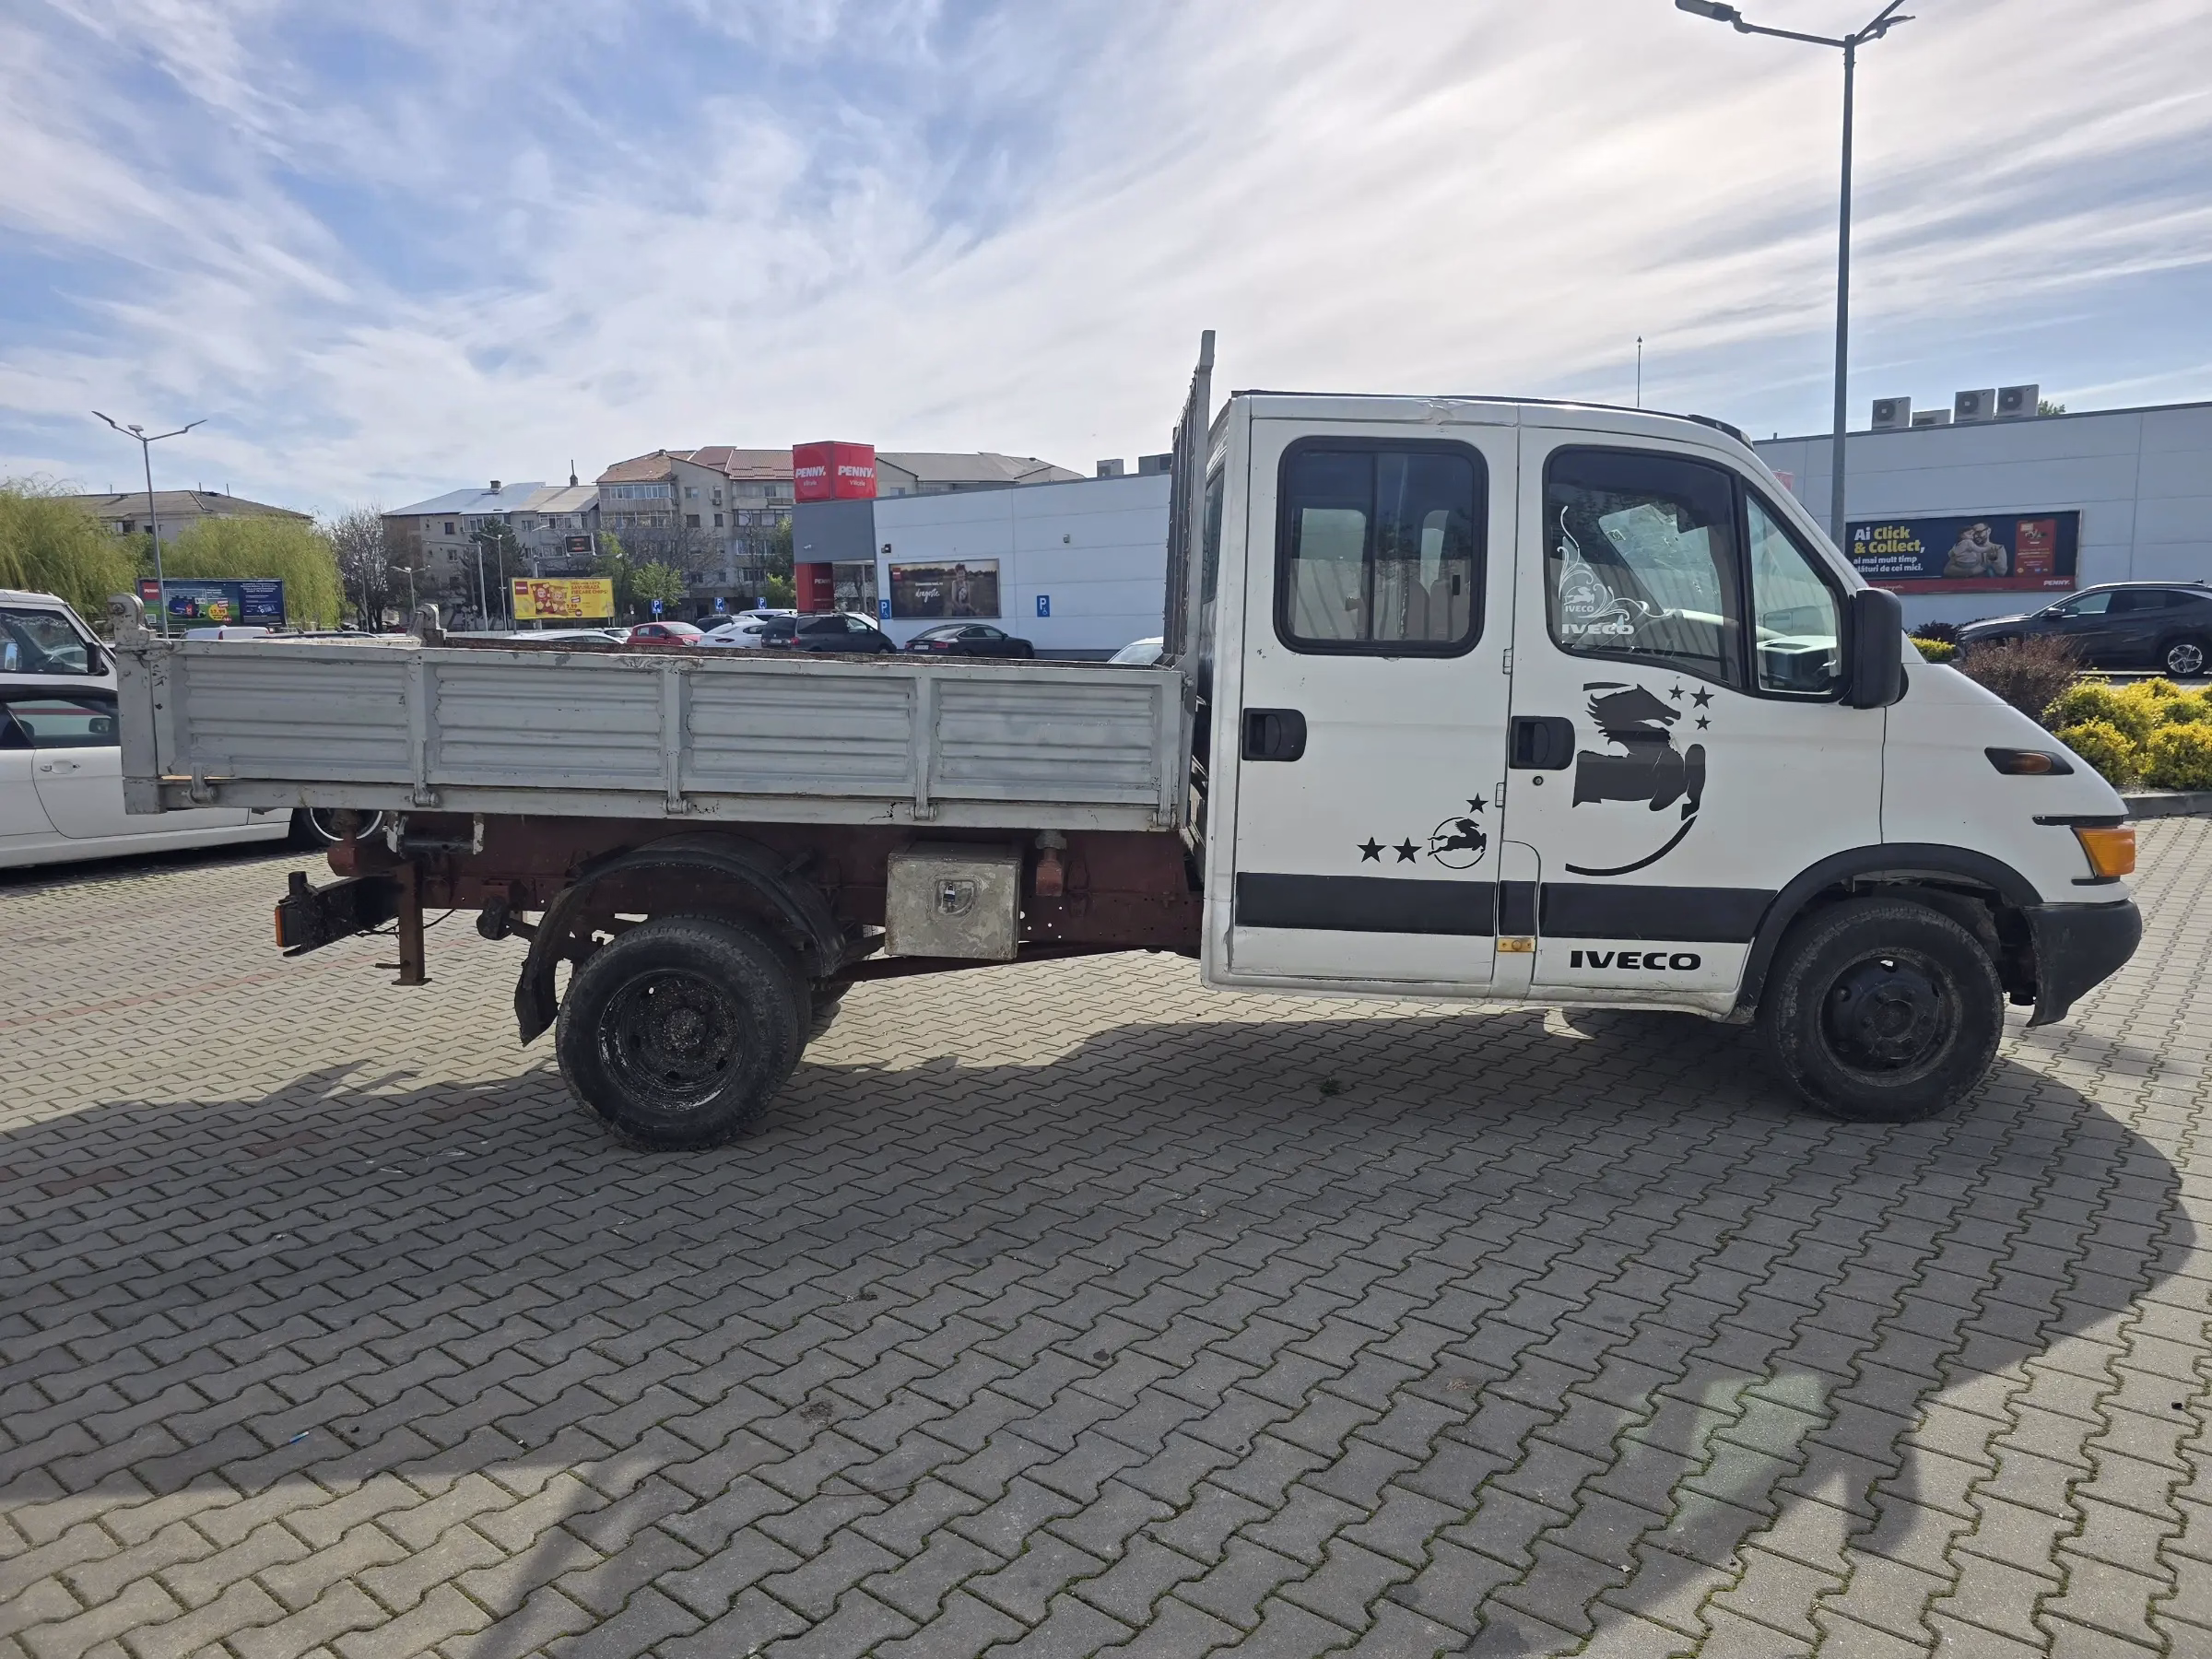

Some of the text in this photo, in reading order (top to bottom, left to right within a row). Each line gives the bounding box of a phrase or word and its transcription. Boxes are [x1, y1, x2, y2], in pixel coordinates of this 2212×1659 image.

[1854, 525, 1911, 541] Ai Click
[1853, 539, 1925, 554] & Collect,
[1899, 555, 1917, 564] timp
[1891, 563, 1902, 571] cei
[880, 601, 888, 614] P
[1040, 597, 1047, 610] P
[1562, 624, 1635, 635] IVECO
[1570, 950, 1701, 971] IVECO
